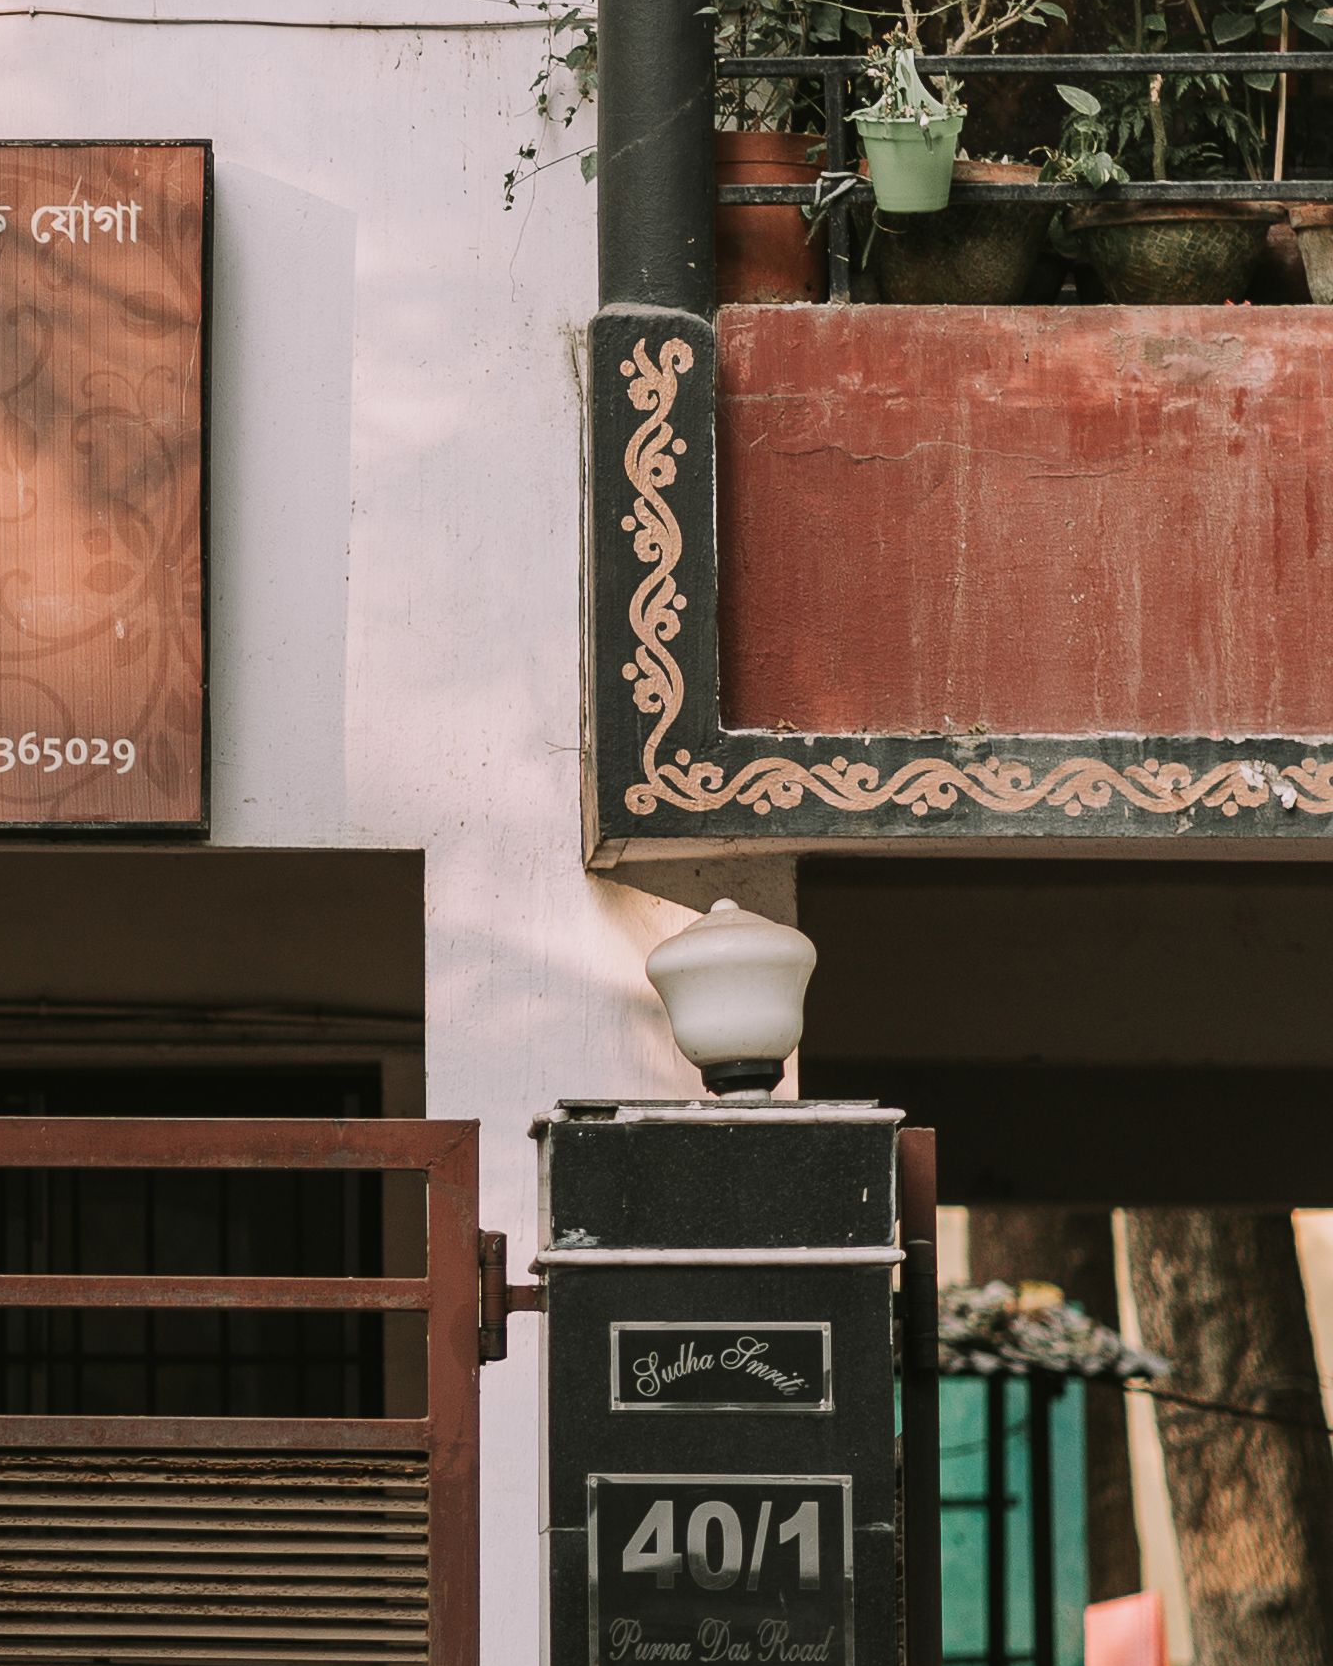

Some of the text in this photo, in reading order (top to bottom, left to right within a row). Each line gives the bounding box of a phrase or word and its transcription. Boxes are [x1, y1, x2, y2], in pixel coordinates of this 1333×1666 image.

[30, 199, 143, 244] যোগা
[633, 1336, 811, 1397] Sudha Smriti
[621, 1499, 821, 1592] 40/1
[608, 1617, 837, 1663] Purna Das Road
